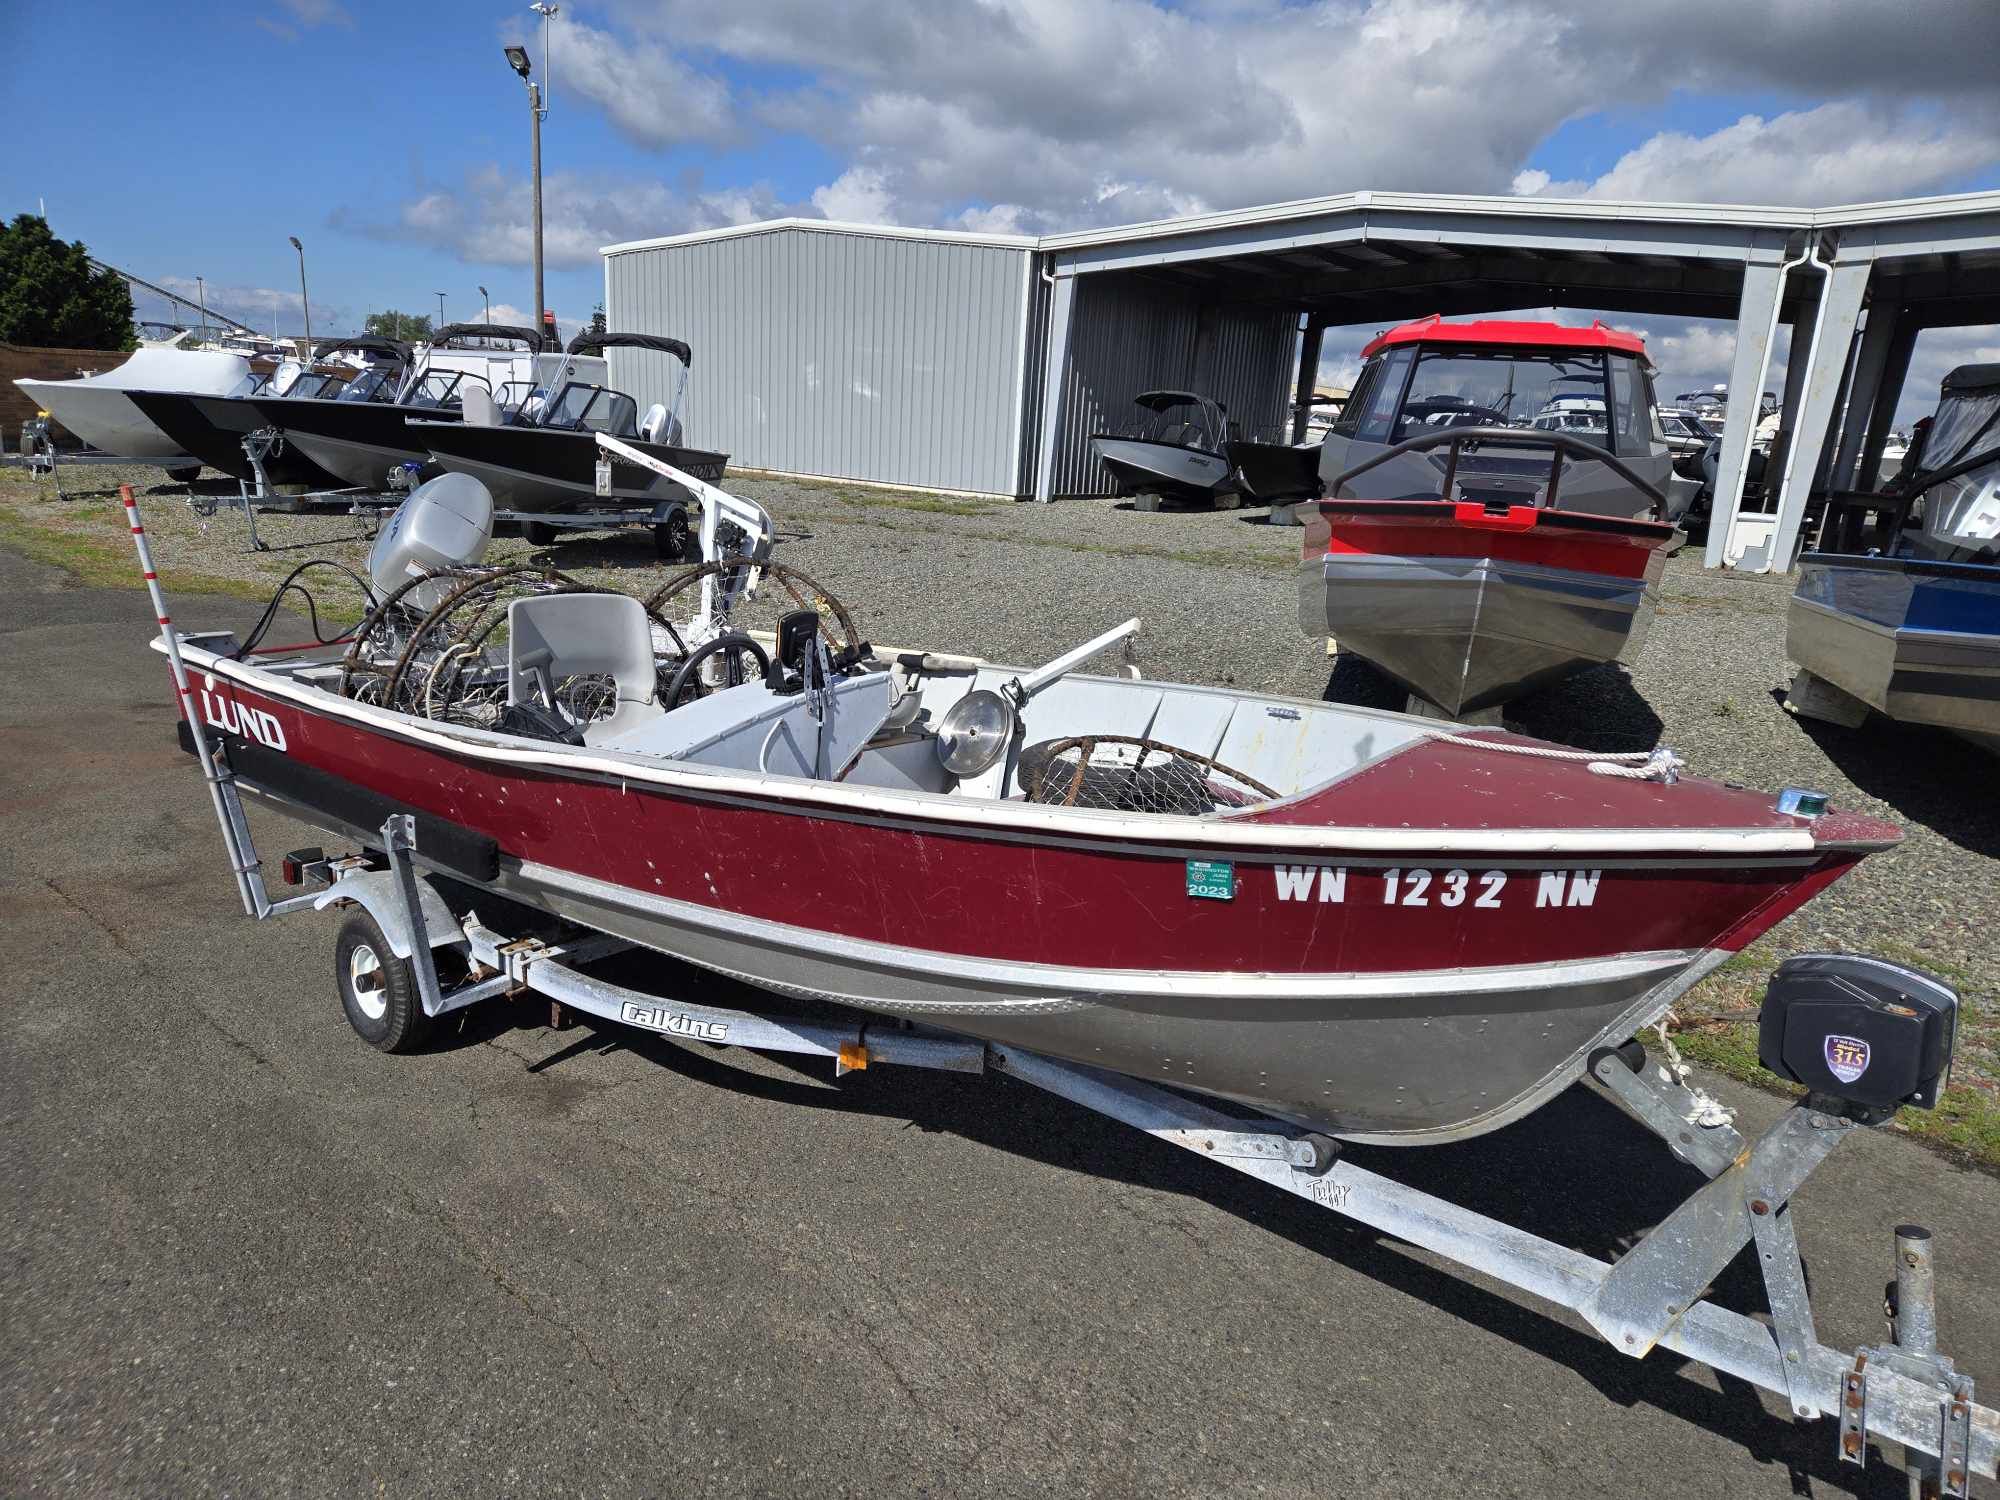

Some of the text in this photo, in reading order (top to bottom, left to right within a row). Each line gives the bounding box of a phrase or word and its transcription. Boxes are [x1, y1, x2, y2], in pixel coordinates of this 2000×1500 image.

[201, 688, 287, 752] LUND
[1188, 884, 1228, 896] 2023
[1274, 864, 1602, 908] WN 1232 NN
[621, 1001, 728, 1040] Calkins
[1833, 1048, 1866, 1065] 315
